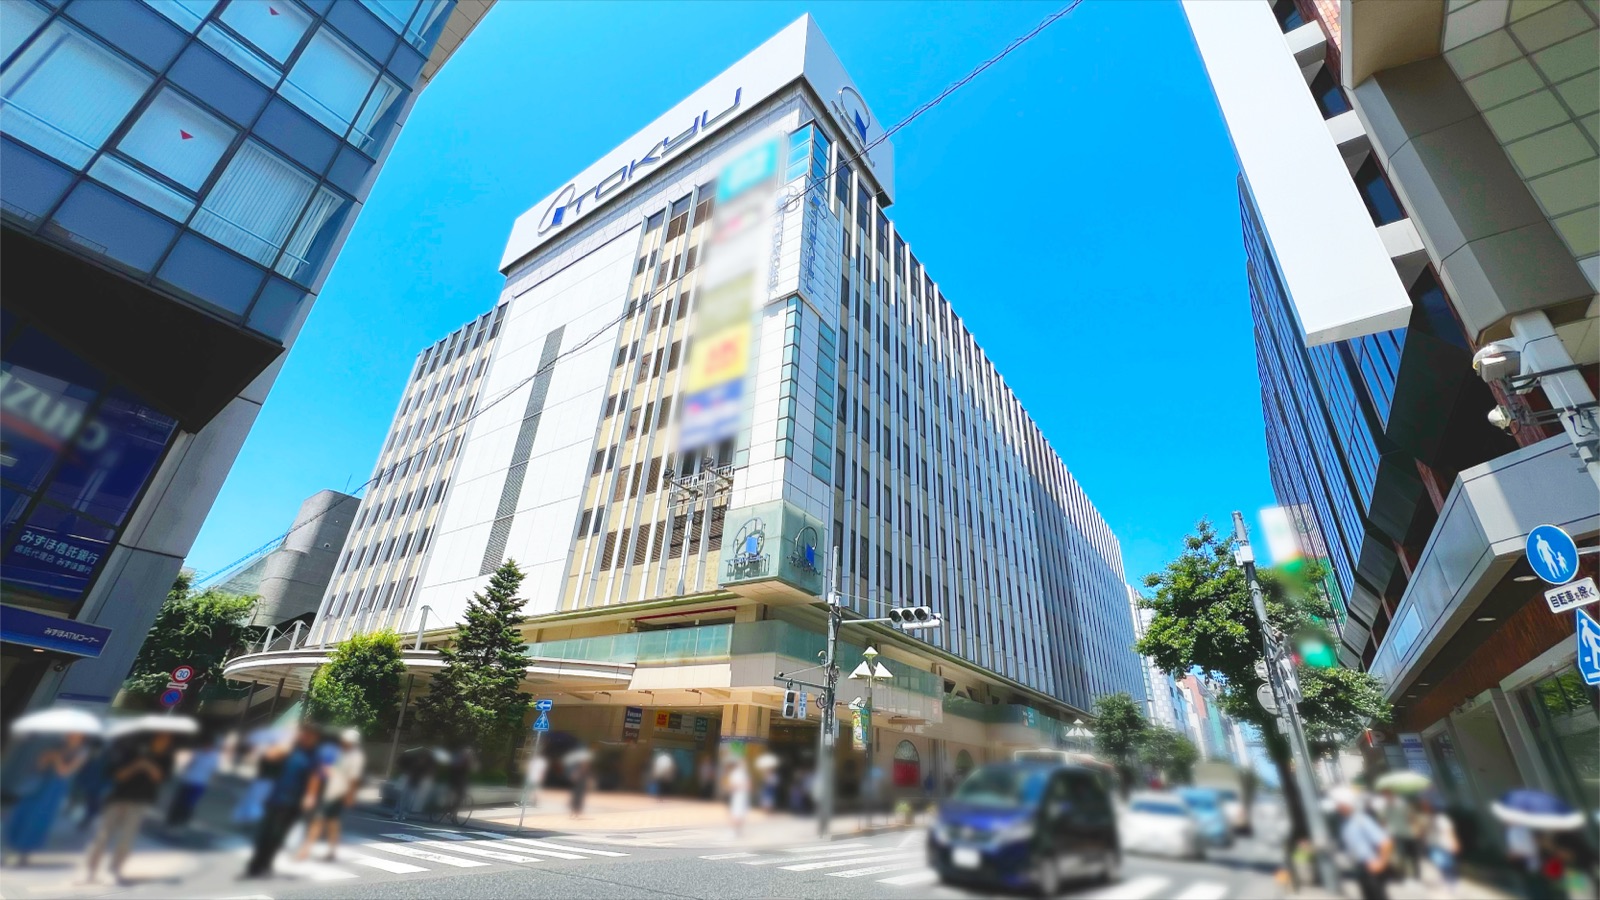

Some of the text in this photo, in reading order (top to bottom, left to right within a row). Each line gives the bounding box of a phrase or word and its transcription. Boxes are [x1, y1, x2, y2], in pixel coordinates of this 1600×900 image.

[565, 87, 742, 215] TOKYU
[20, 530, 100, 565] みずほ信託銀行
[56, 557, 93, 575] みずほ銀行
[1550, 585, 1596, 608] 自転車を除く
[44, 627, 100, 643] みずほATMコーナー
[177, 669, 189, 679] 30
